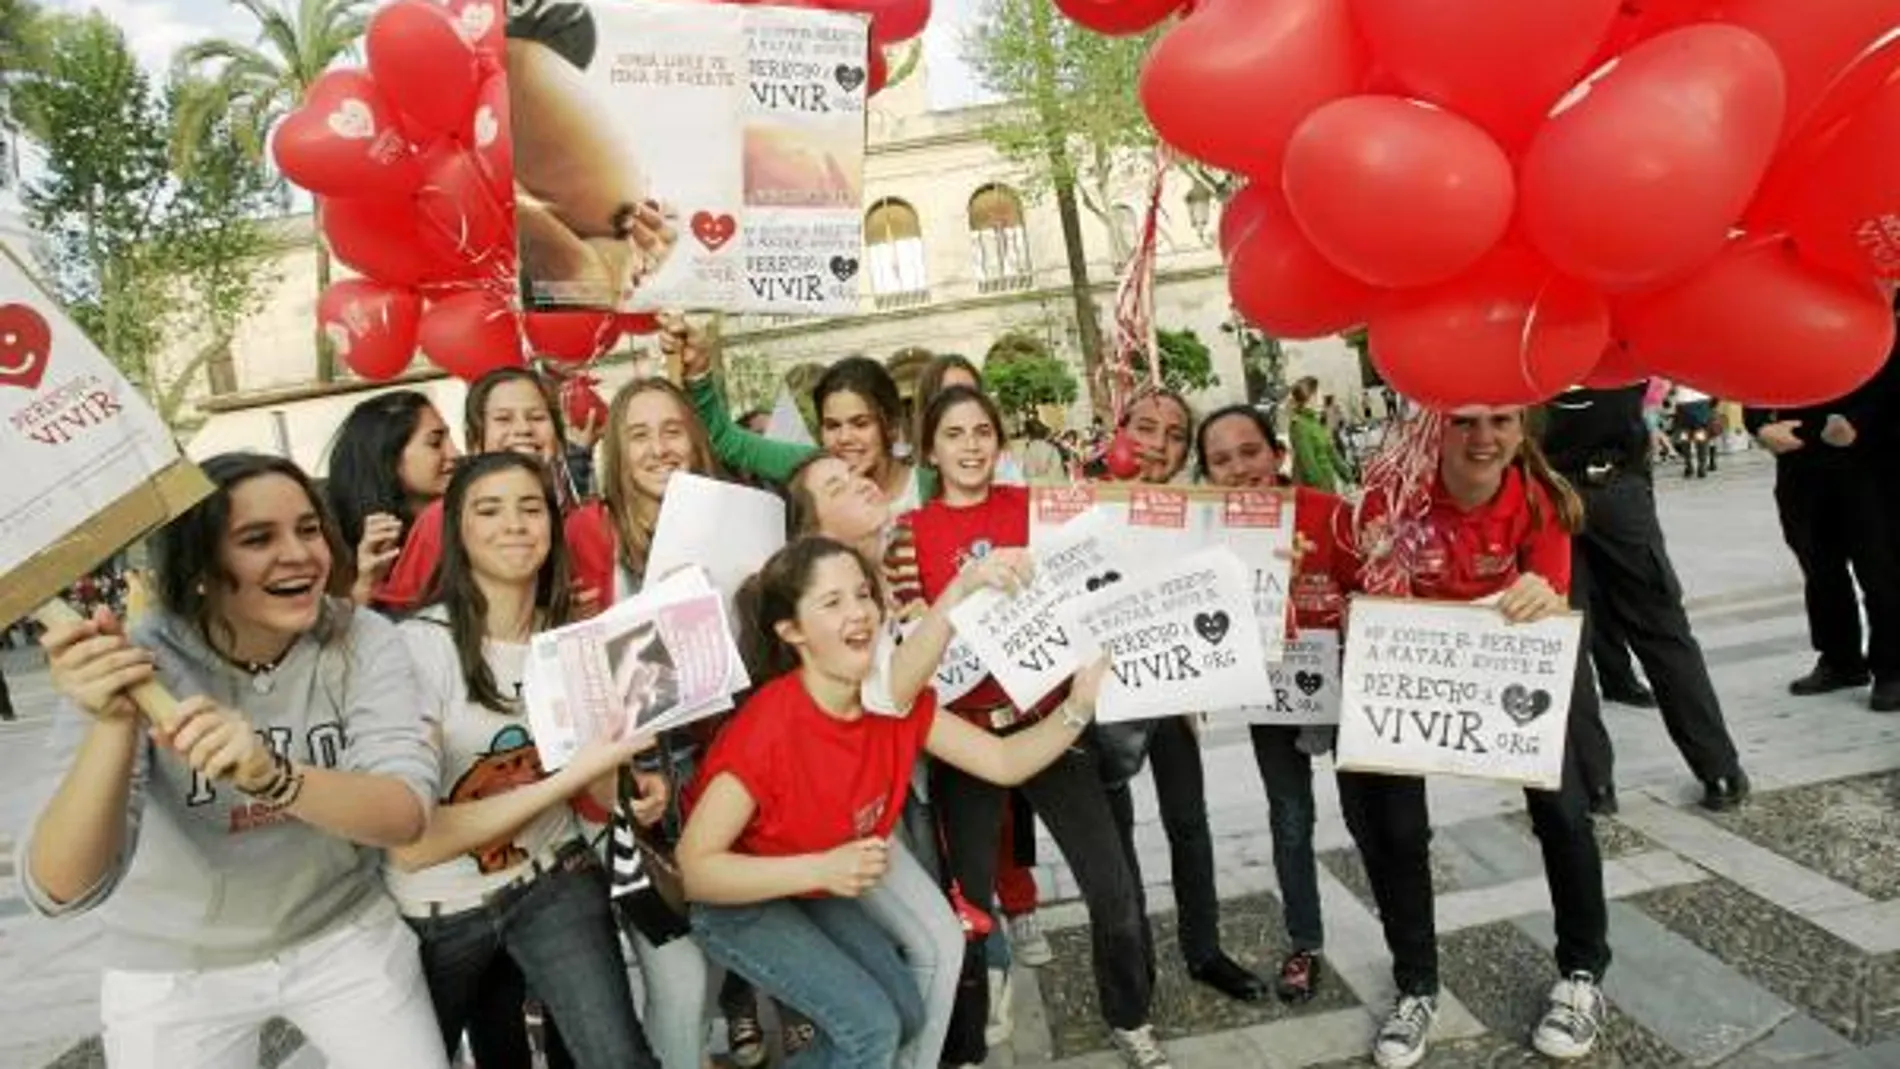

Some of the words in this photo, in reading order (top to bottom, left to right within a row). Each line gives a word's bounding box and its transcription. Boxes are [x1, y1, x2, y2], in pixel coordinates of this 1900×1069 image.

[749, 82, 831, 112] VIVIR
[748, 274, 825, 301] VIVIR
[30, 391, 123, 444] VIVIR
[1111, 645, 1201, 688] VIVIR
[1363, 672, 1478, 704] DERECHO
[1363, 705, 1489, 754] VIVIR
